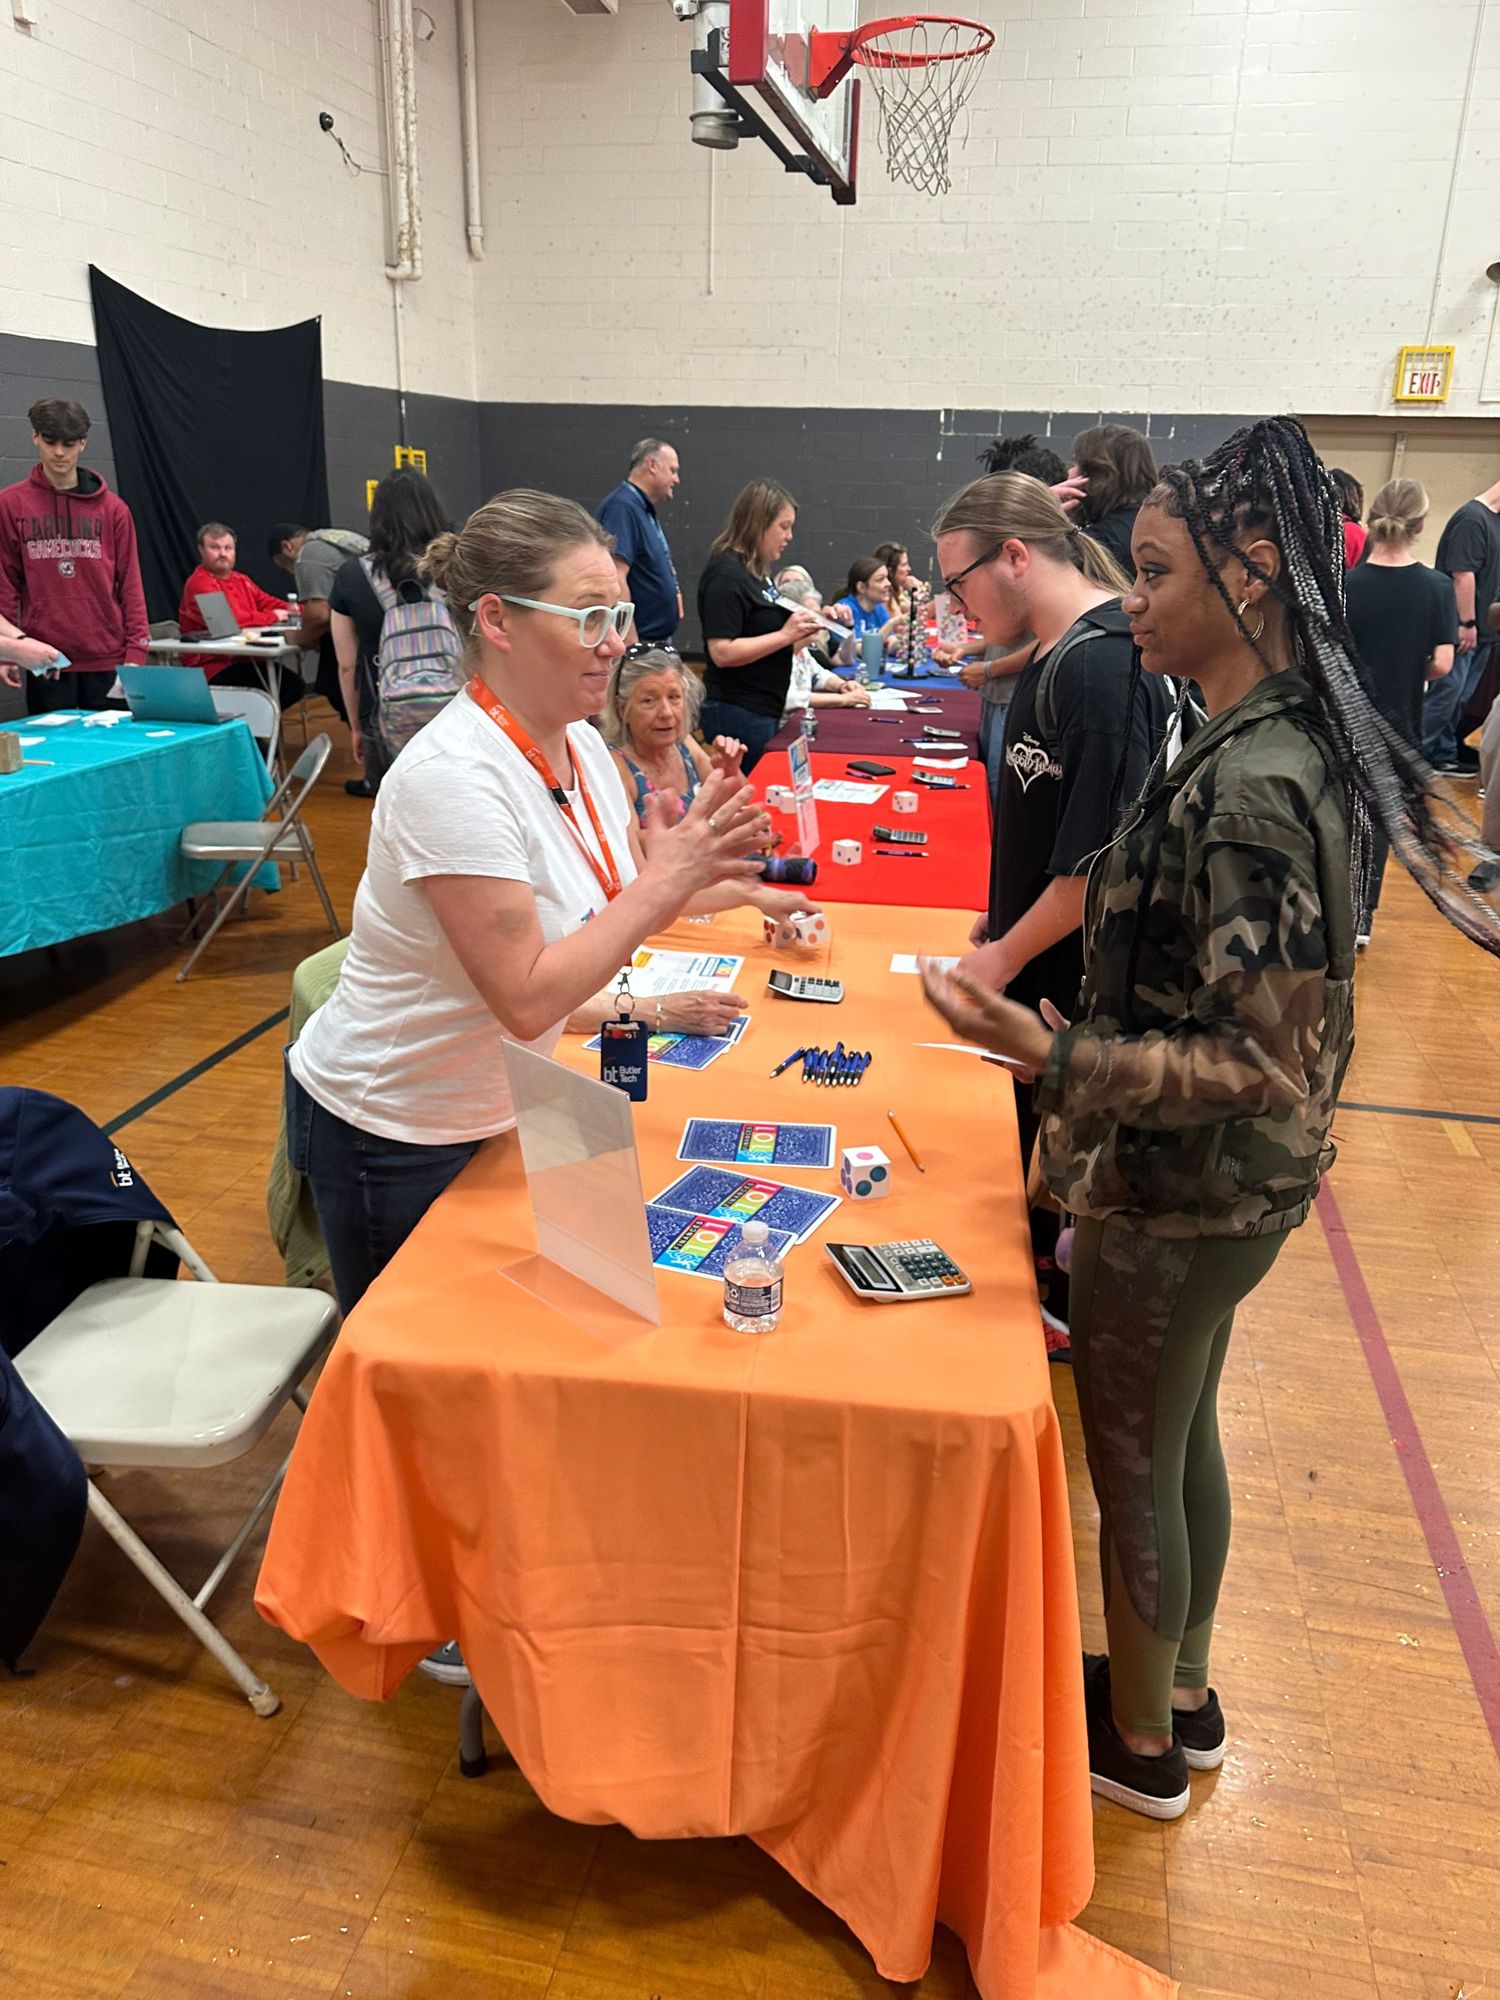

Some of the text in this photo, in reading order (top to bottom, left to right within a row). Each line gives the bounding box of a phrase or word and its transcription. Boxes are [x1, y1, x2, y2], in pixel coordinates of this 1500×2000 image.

[1408, 372, 1439, 395] EXIT
[603, 1066, 642, 1082] bt Butler
[619, 1074, 638, 1083] Tech
[751, 1126, 776, 1149] 101
[724, 1181, 755, 1208] FINANCES
[735, 1184, 777, 1211] 101
[673, 1220, 704, 1250] FINANCES
[686, 1222, 728, 1251] 101
